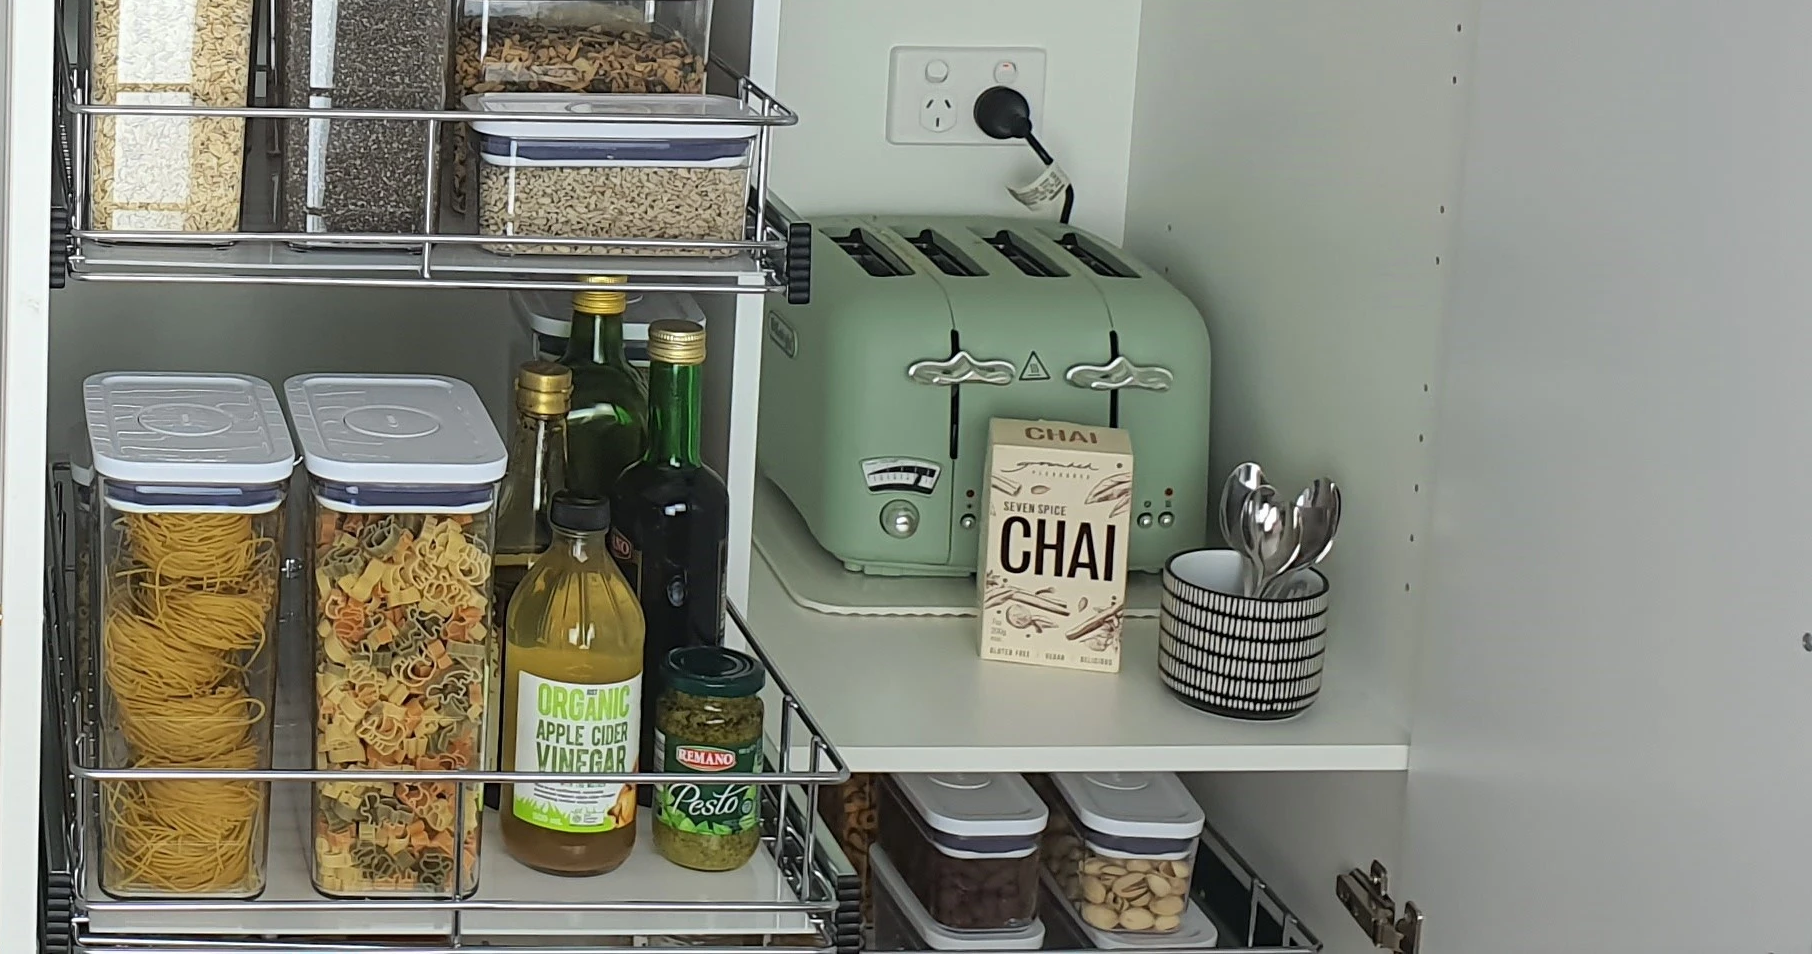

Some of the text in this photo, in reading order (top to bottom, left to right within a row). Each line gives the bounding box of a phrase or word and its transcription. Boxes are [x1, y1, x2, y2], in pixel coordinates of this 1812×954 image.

[1024, 426, 1098, 444] CHAI
[1003, 500, 1067, 517] SEVEN SPICE
[999, 515, 1117, 582] CHAI
[537, 682, 631, 721] ORGANIC
[536, 719, 628, 746] APPLE CIDER
[536, 741, 627, 774] VINEGAR
[677, 748, 734, 766] REMANO
[668, 783, 750, 816] Pesto
